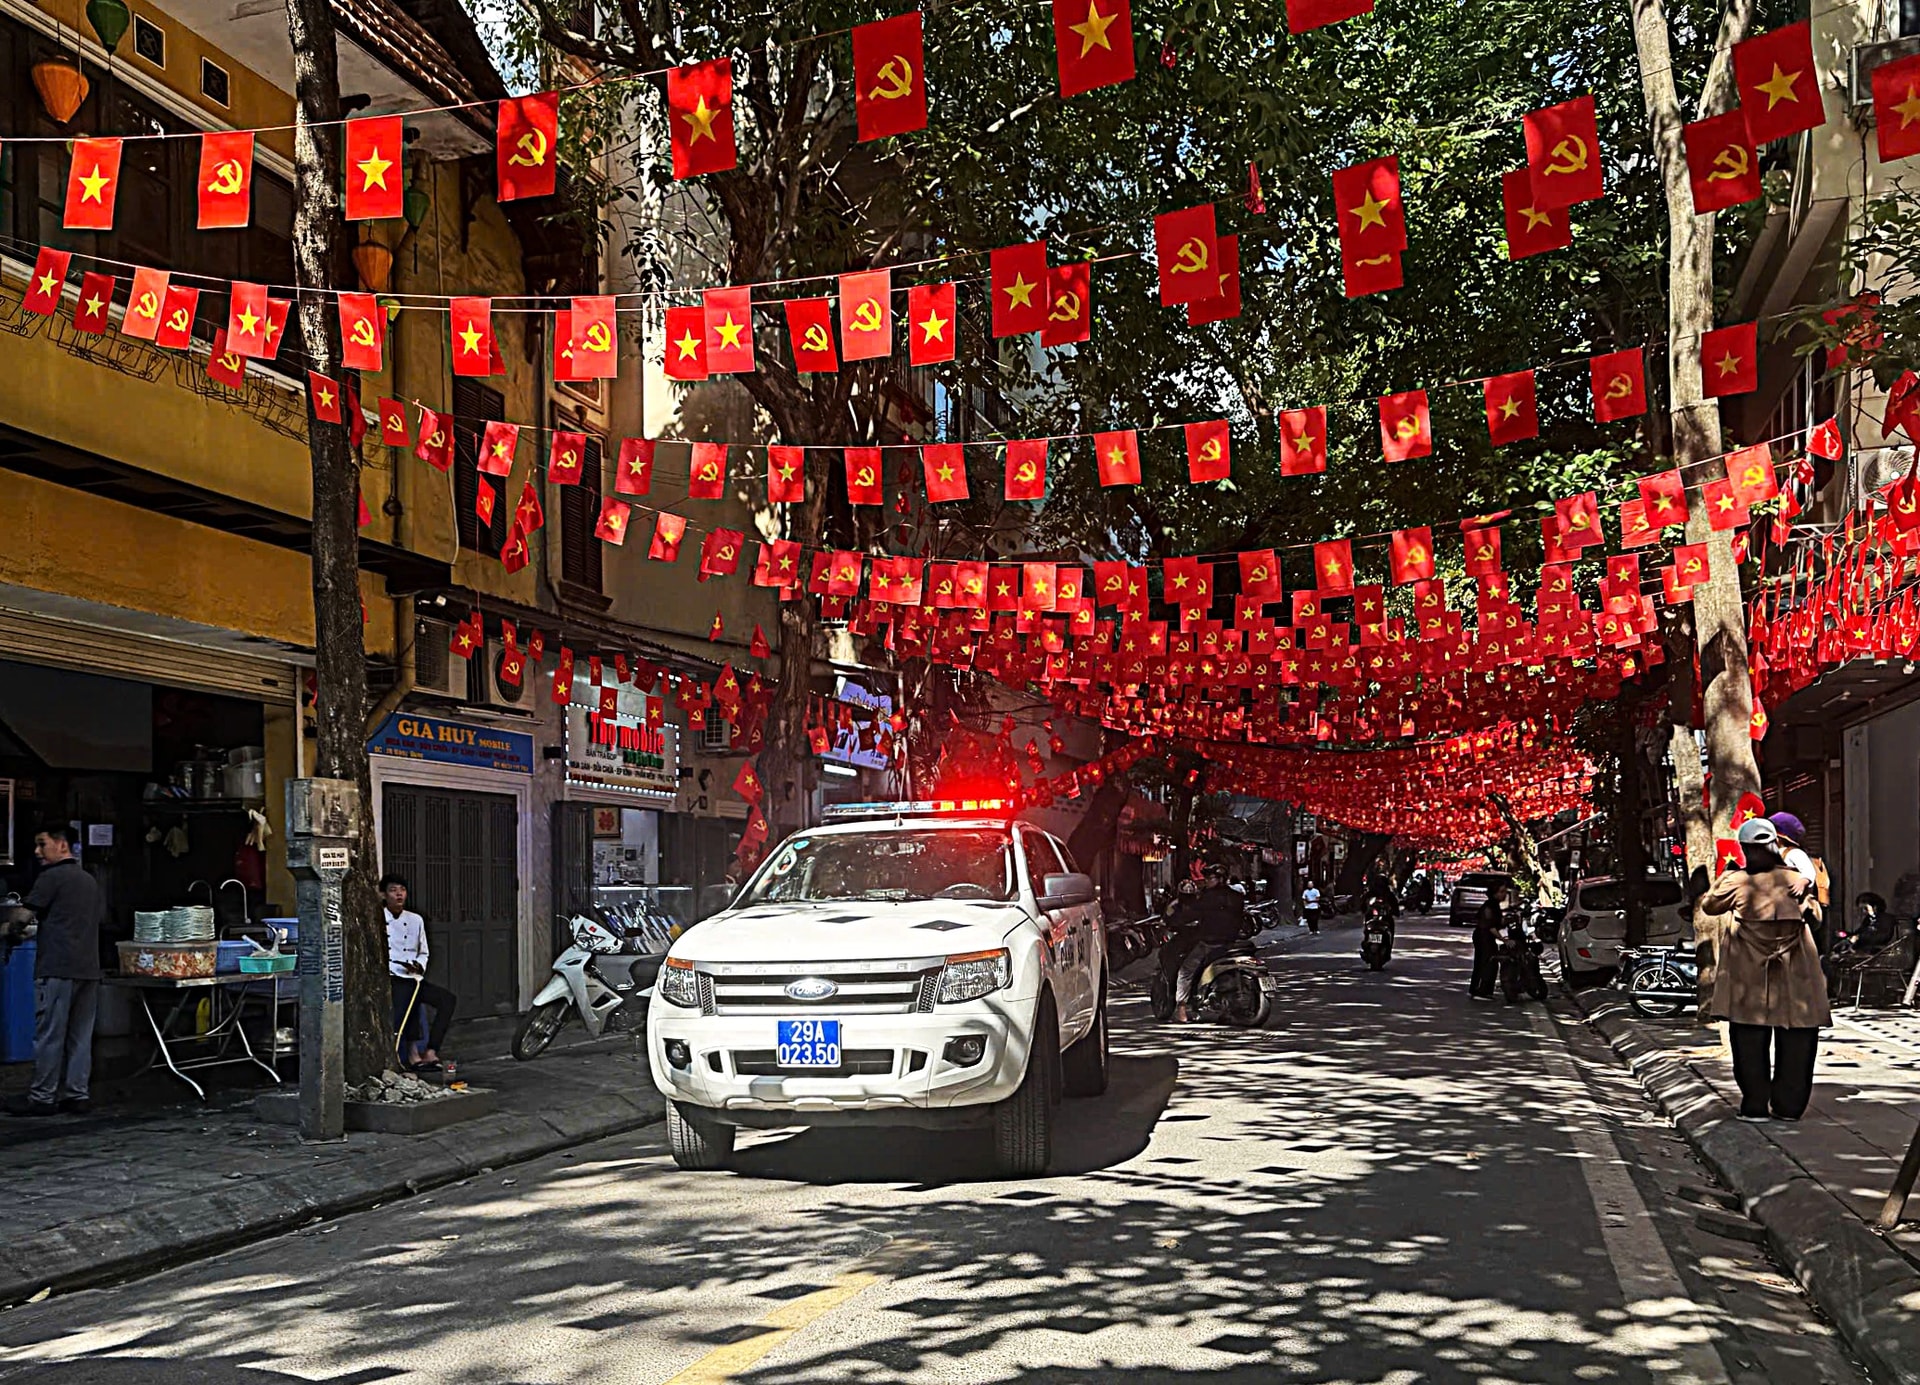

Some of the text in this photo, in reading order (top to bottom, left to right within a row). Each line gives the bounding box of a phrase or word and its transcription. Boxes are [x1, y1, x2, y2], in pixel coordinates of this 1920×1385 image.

[397, 719, 434, 740] GIA
[437, 725, 477, 746] HUY
[479, 738, 512, 751] MOBILE
[619, 723, 665, 755] mobile
[791, 1020, 825, 1043] 29A
[778, 1042, 839, 1065] 023.50
